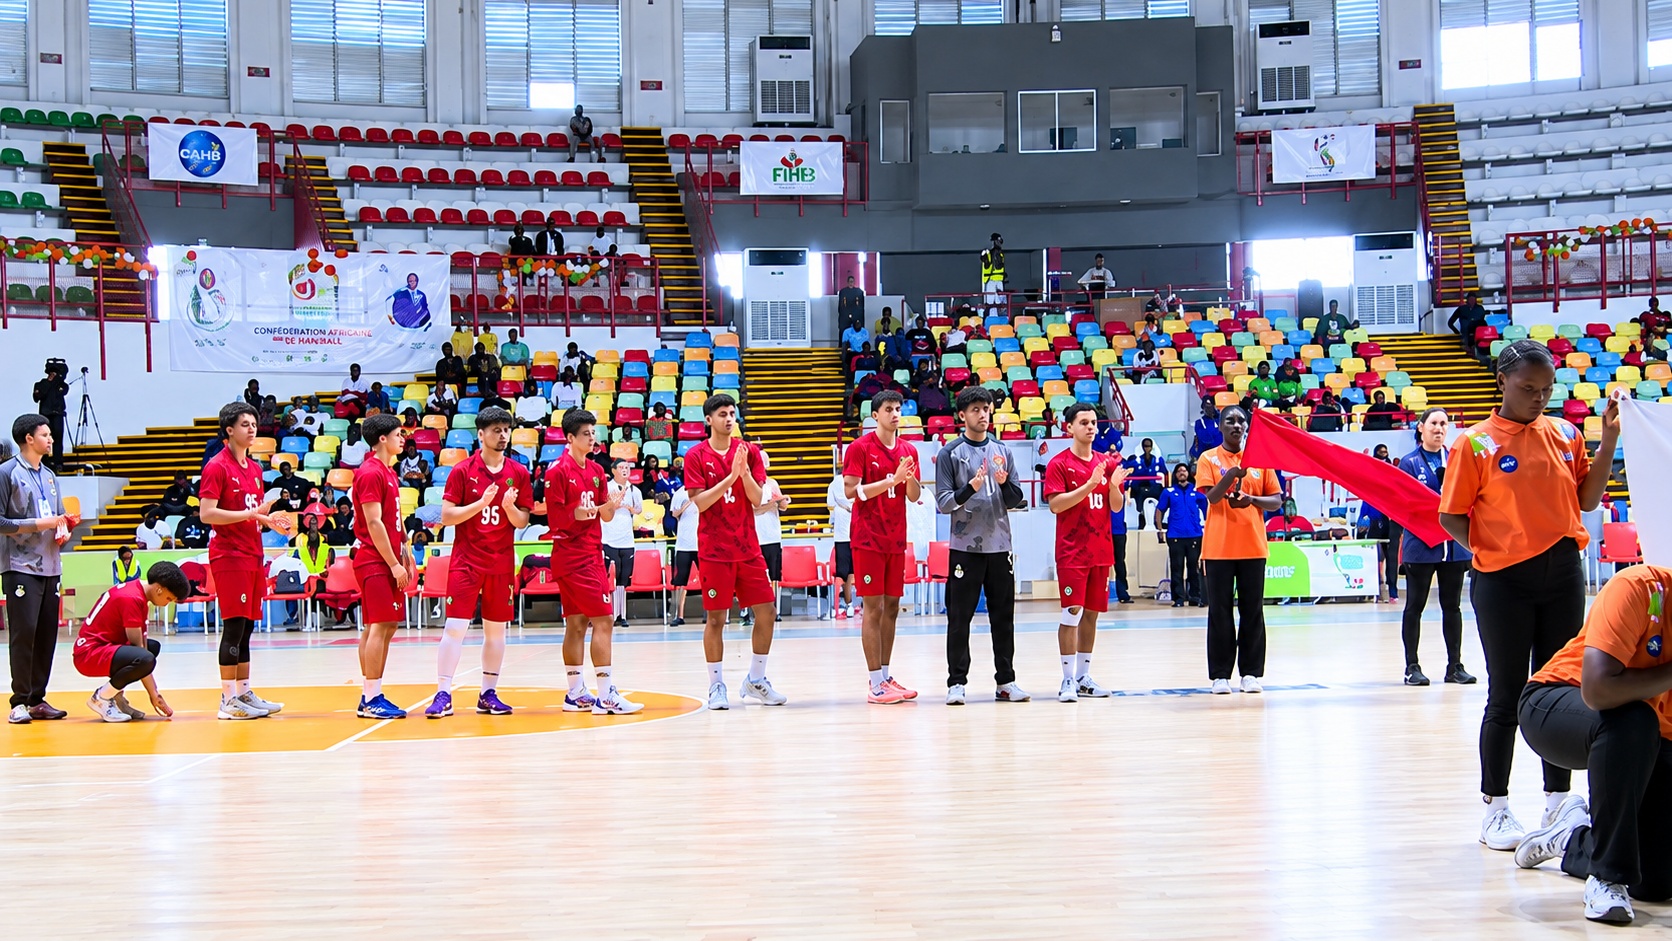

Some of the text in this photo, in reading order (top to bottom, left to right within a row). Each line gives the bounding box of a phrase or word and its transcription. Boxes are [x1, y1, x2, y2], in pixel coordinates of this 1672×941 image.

[180, 149, 221, 161] CAHB
[772, 167, 816, 182] FIHB
[481, 505, 500, 525] 95
